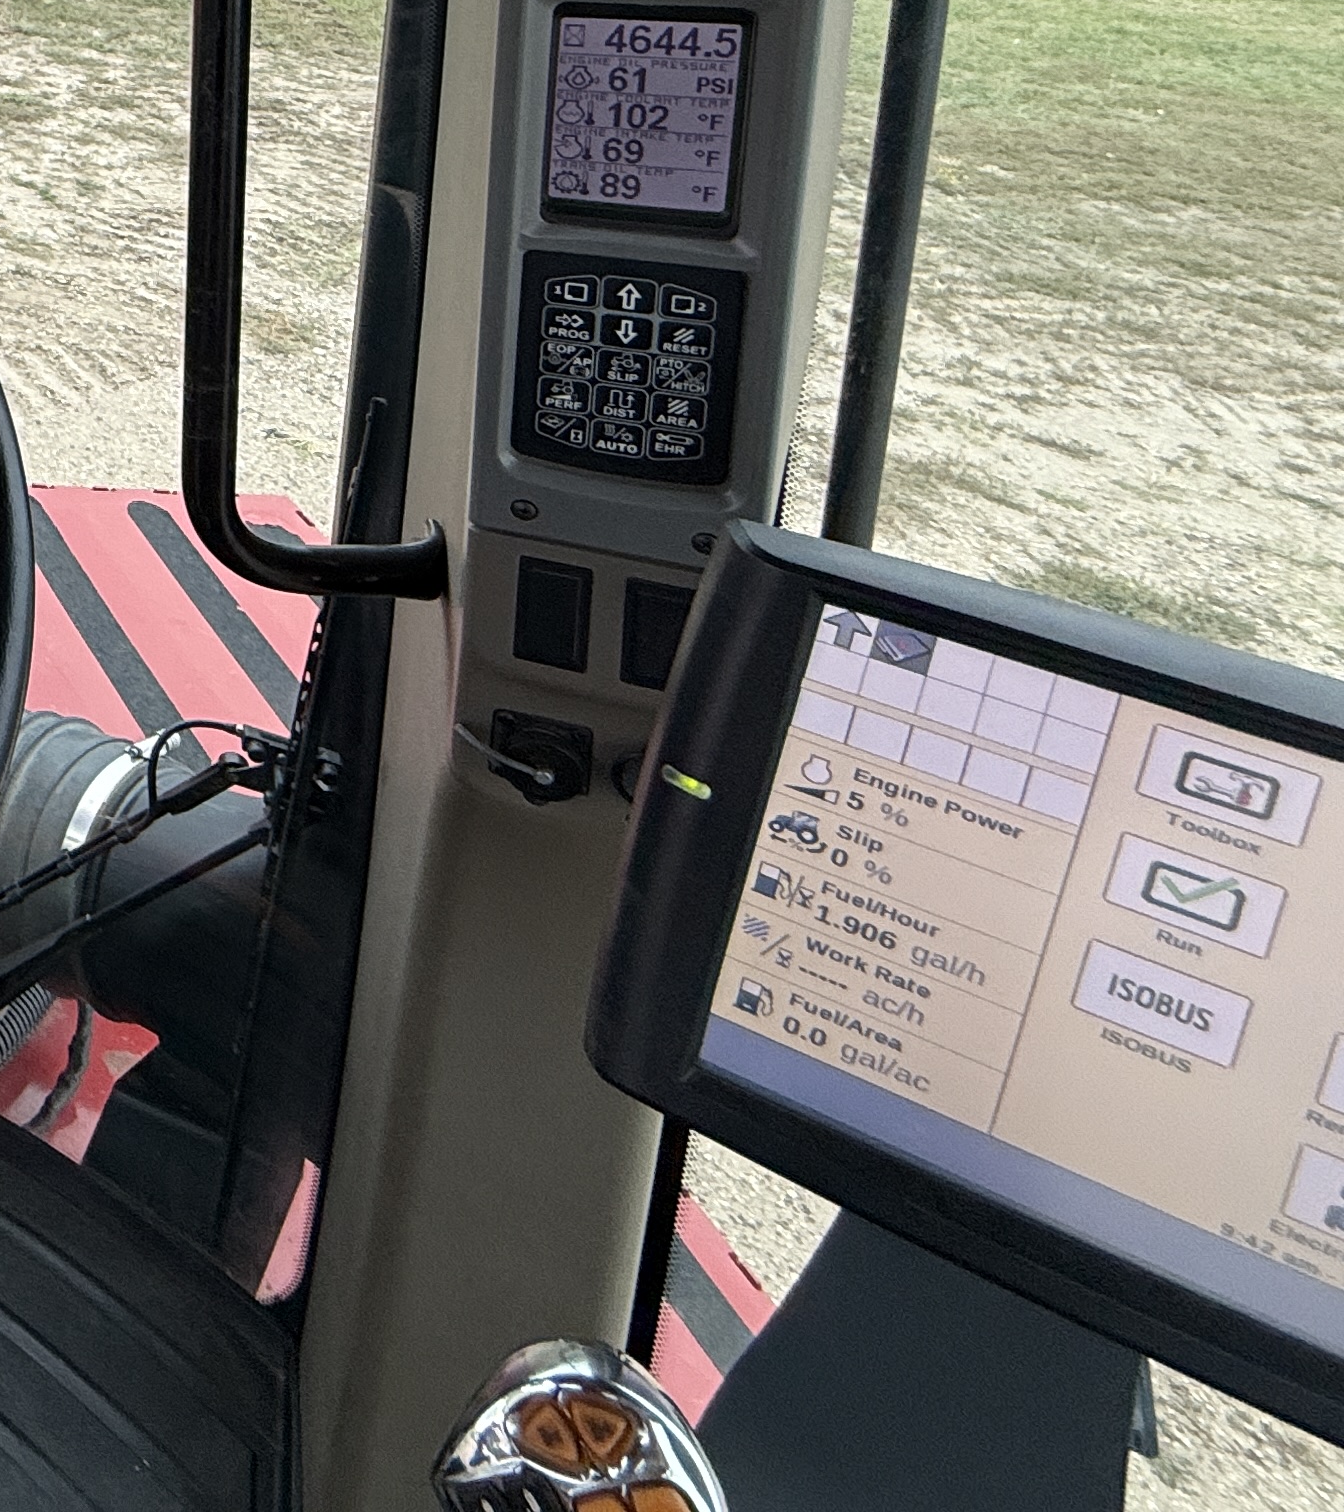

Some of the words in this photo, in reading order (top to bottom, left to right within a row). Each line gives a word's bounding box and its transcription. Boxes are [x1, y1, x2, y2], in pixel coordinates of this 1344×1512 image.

[604, 24, 738, 59] 4644.5
[559, 56, 611, 67] ENGINE
[651, 60, 728, 73] PRESSURE
[608, 67, 647, 94] 61
[696, 77, 733, 95] PSI
[608, 102, 669, 131] 102
[697, 113, 725, 130] °F
[602, 138, 644, 164] 69
[694, 149, 720, 167] °F
[599, 172, 641, 200] 89
[691, 185, 719, 203] °F
[698, 302, 707, 312] 2
[546, 343, 577, 354] EOP
[548, 327, 590, 341] PROG
[662, 341, 708, 356] RESET
[572, 357, 592, 366] AP
[660, 358, 684, 369] PTO
[607, 371, 639, 382] SLIP
[670, 381, 705, 393] HITCH
[545, 397, 583, 410] PERF
[603, 406, 636, 419] DIST
[656, 414, 699, 428] AREA
[595, 439, 638, 454] AUTO
[654, 442, 686, 456] EHR
[846, 791, 865, 811] 5
[880, 802, 909, 828] %
[853, 766, 937, 809] Engine
[944, 798, 1025, 840] Power
[835, 824, 883, 854] Slip
[1165, 810, 1262, 856] Toolbox
[831, 848, 849, 868] 0
[863, 860, 892, 885] %
[820, 880, 941, 938] Fuel/Hour
[814, 904, 898, 950] 1.906
[910, 945, 987, 986] gal/h
[1155, 928, 1203, 957] Run
[805, 936, 869, 974] Work
[874, 965, 932, 999] Rate
[862, 989, 925, 1026] ac/h
[1107, 973, 1215, 1033] ISOBUS
[789, 992, 903, 1052] Fuel/Area
[783, 1016, 827, 1047] 0.0
[840, 1043, 932, 1093] gal/ac
[1100, 1026, 1193, 1074] ISOBUS
